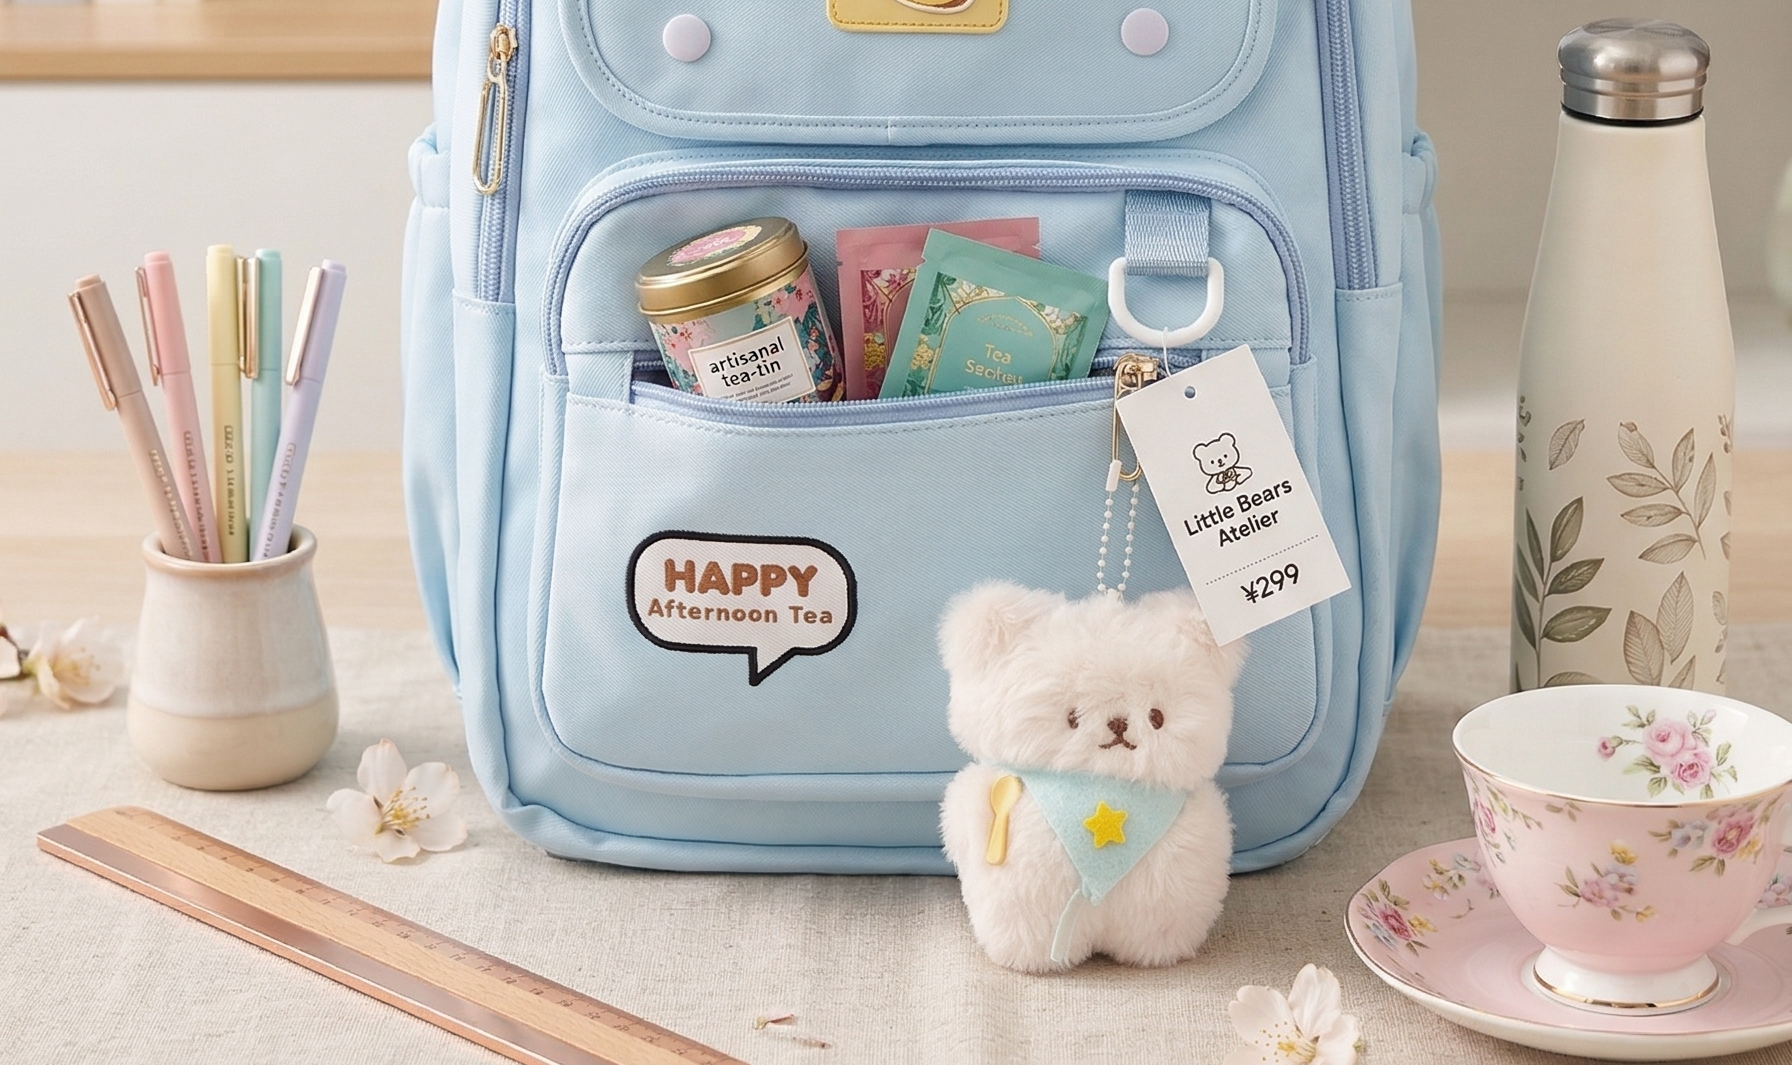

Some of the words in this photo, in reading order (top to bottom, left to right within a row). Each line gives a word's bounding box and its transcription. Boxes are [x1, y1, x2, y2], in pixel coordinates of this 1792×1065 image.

[709, 335, 785, 374] artisanal
[721, 360, 781, 387] tea-tin
[985, 343, 1012, 365] Tea
[1183, 503, 1235, 536] Little
[1236, 479, 1293, 514] Bears
[1218, 508, 1280, 548] Atelier
[664, 558, 818, 598] HAPPY
[1240, 563, 1300, 604] ¥299
[648, 598, 778, 623] Afternoon
[788, 605, 833, 624] Tea
